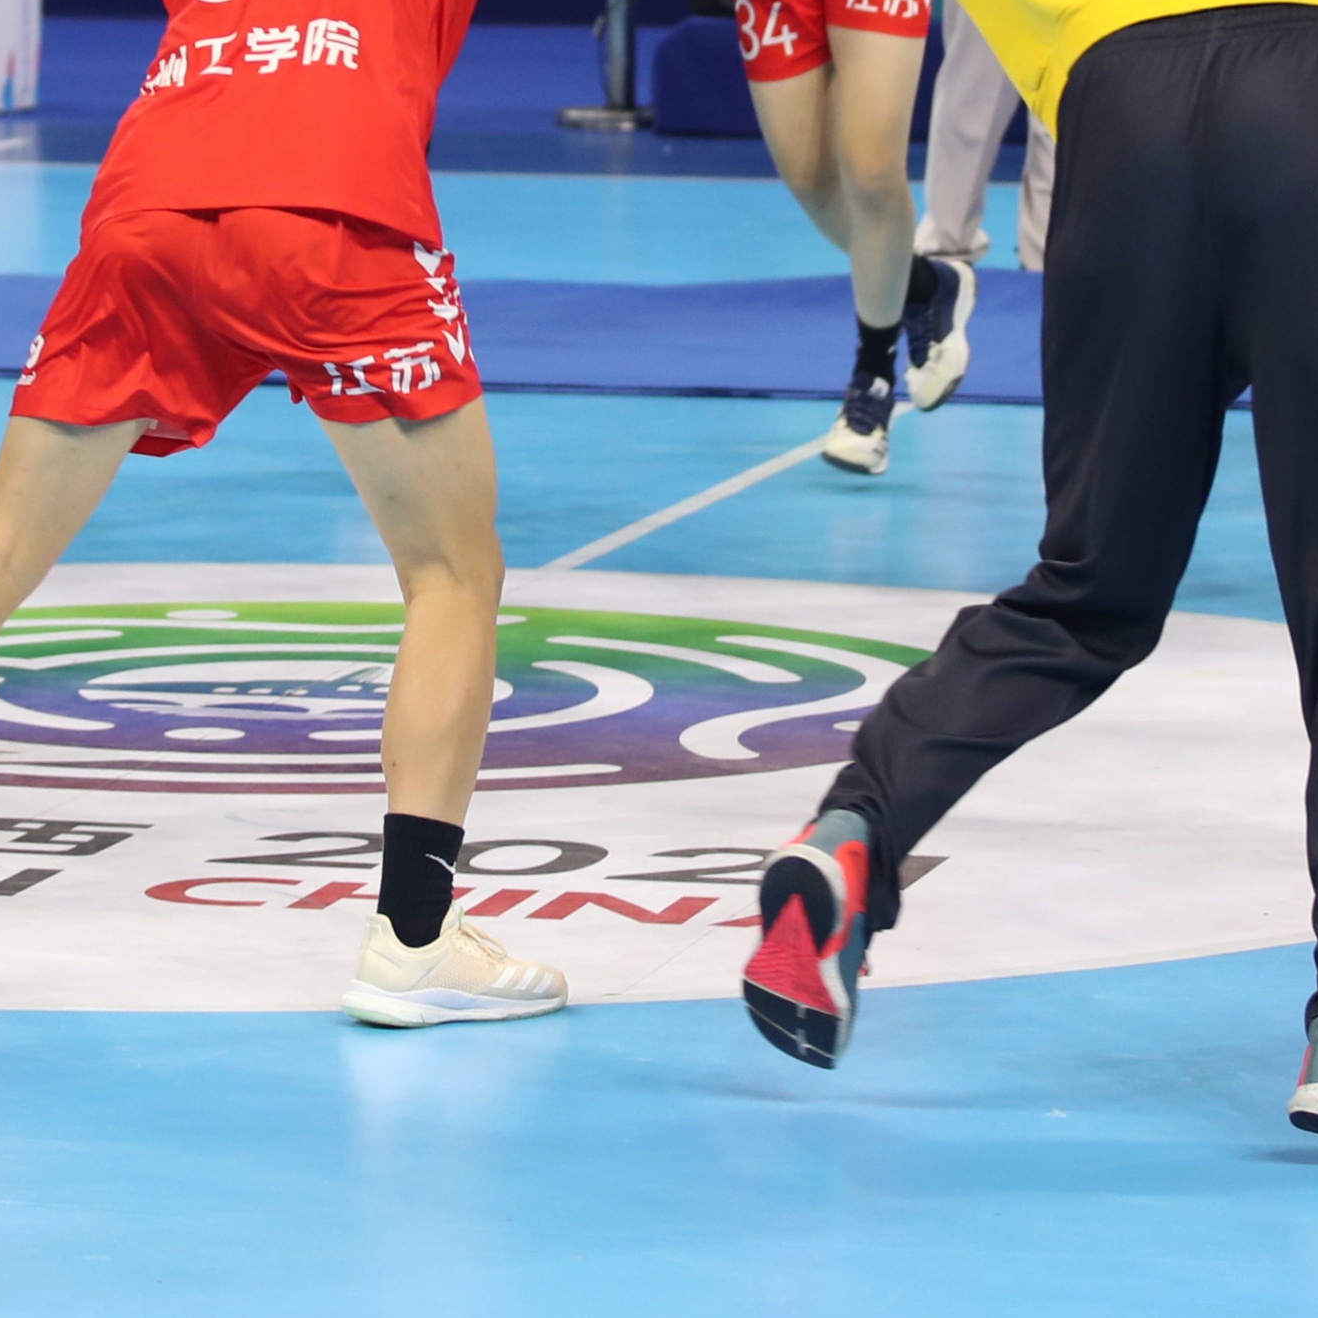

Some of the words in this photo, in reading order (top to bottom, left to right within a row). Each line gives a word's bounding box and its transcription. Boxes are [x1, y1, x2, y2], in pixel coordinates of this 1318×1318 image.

[139, 17, 360, 96] 州工学院
[323, 340, 442, 396] 江苏
